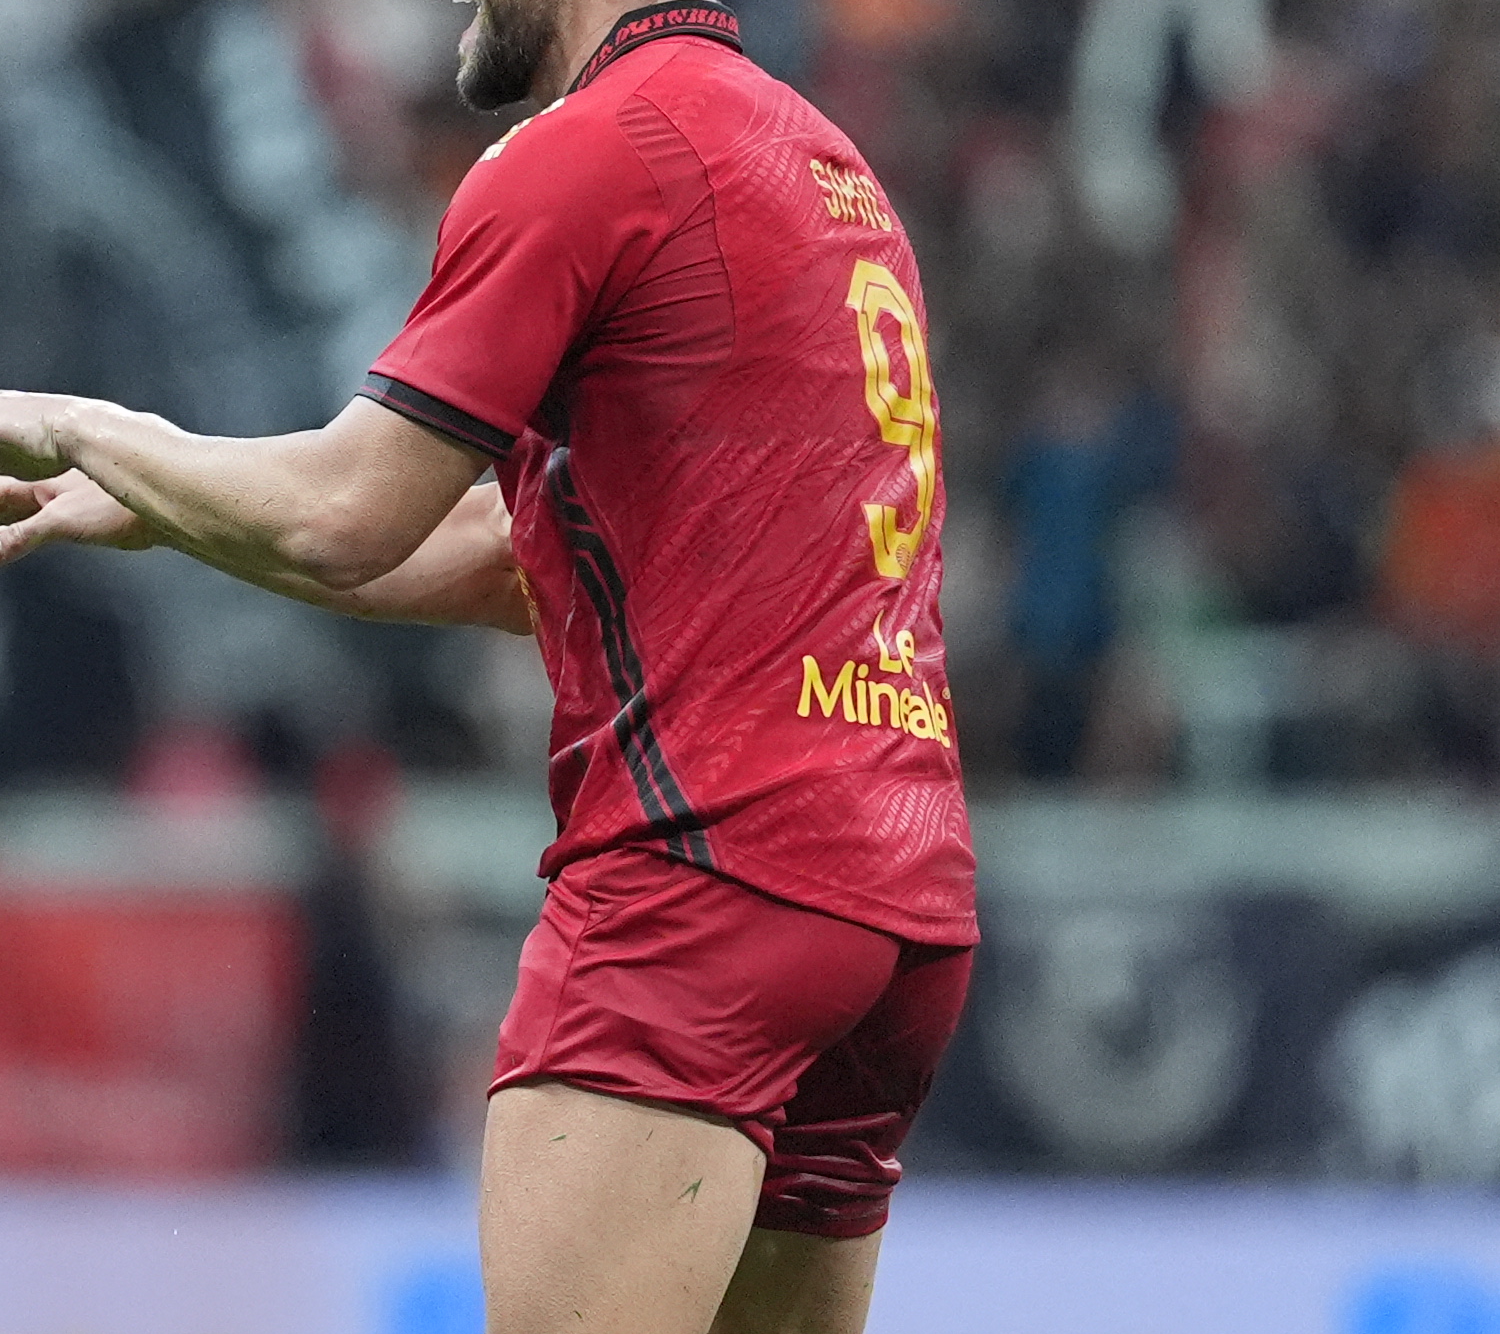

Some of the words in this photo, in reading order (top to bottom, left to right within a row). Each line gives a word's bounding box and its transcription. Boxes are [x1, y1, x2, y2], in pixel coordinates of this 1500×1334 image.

[844, 257, 937, 580] 9
[873, 609, 915, 678] Le
[797, 654, 951, 749] Mineale
